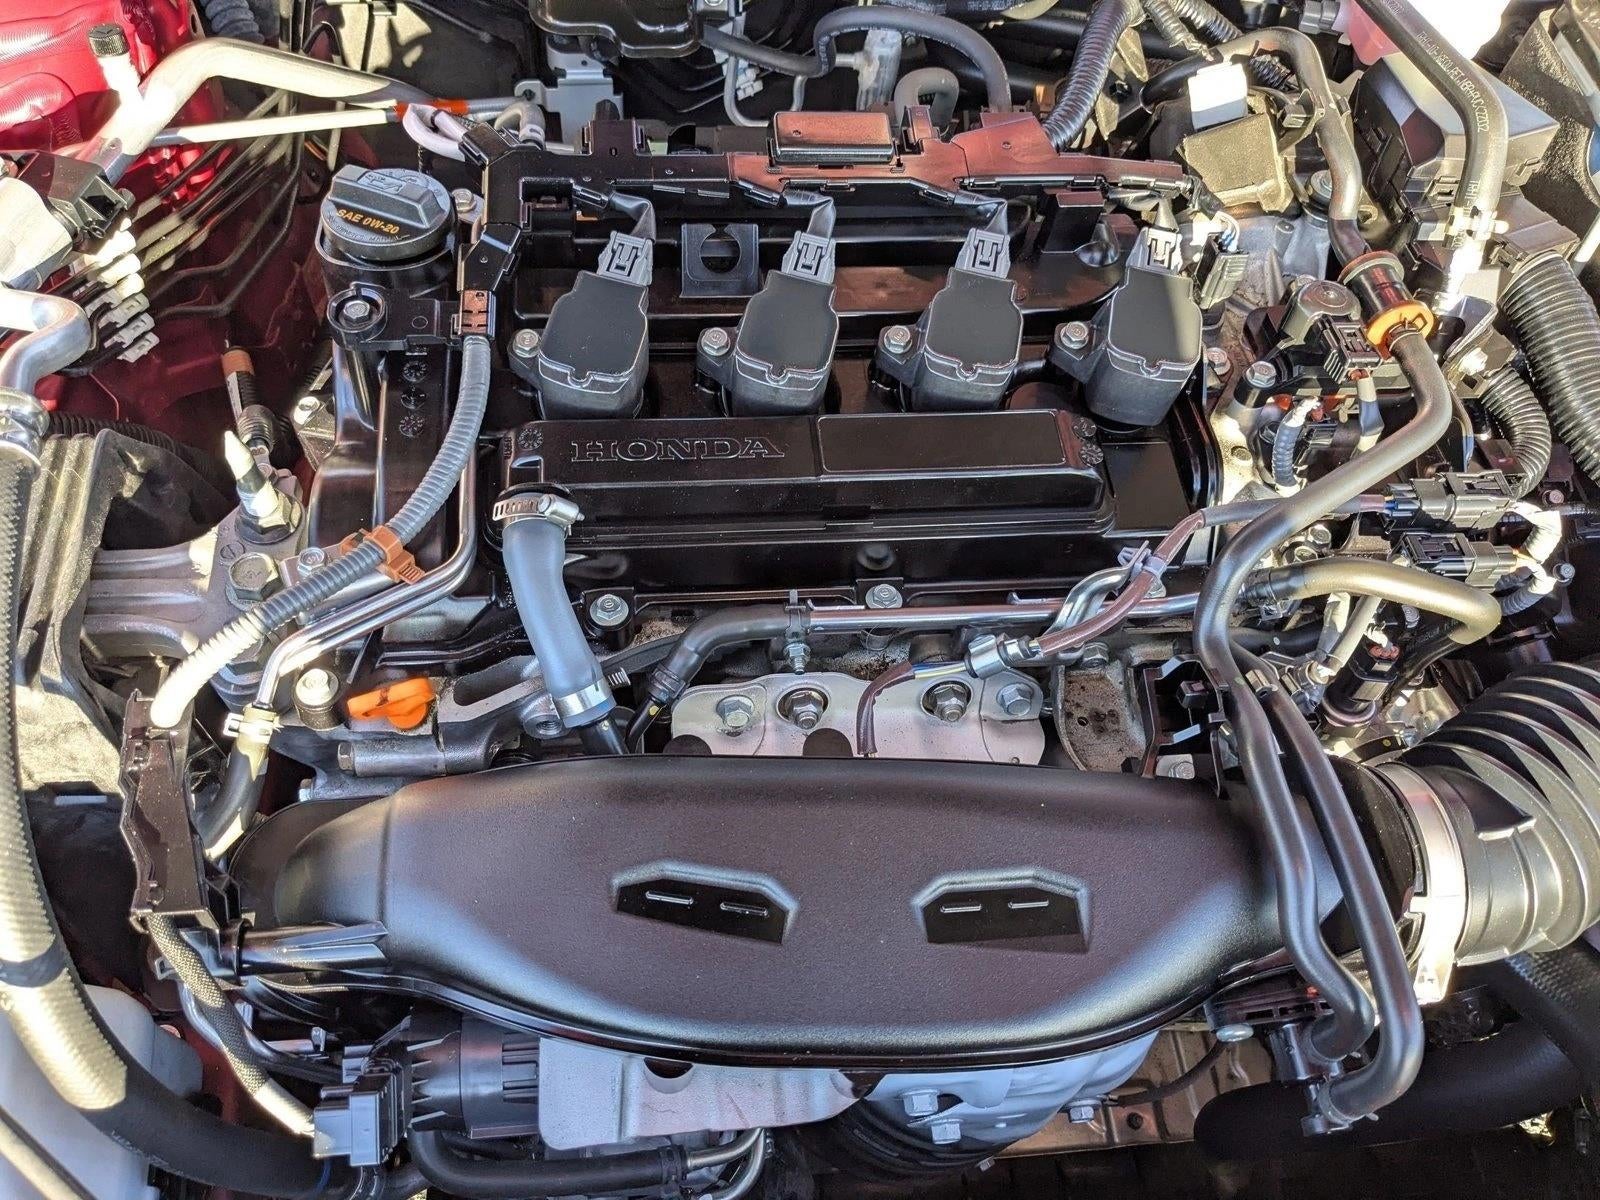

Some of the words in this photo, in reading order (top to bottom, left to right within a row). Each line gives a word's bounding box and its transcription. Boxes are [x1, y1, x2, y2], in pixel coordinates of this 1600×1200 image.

[336, 209, 363, 223] SAE
[362, 217, 400, 234] 0W-20
[571, 437, 785, 462] HONDA
